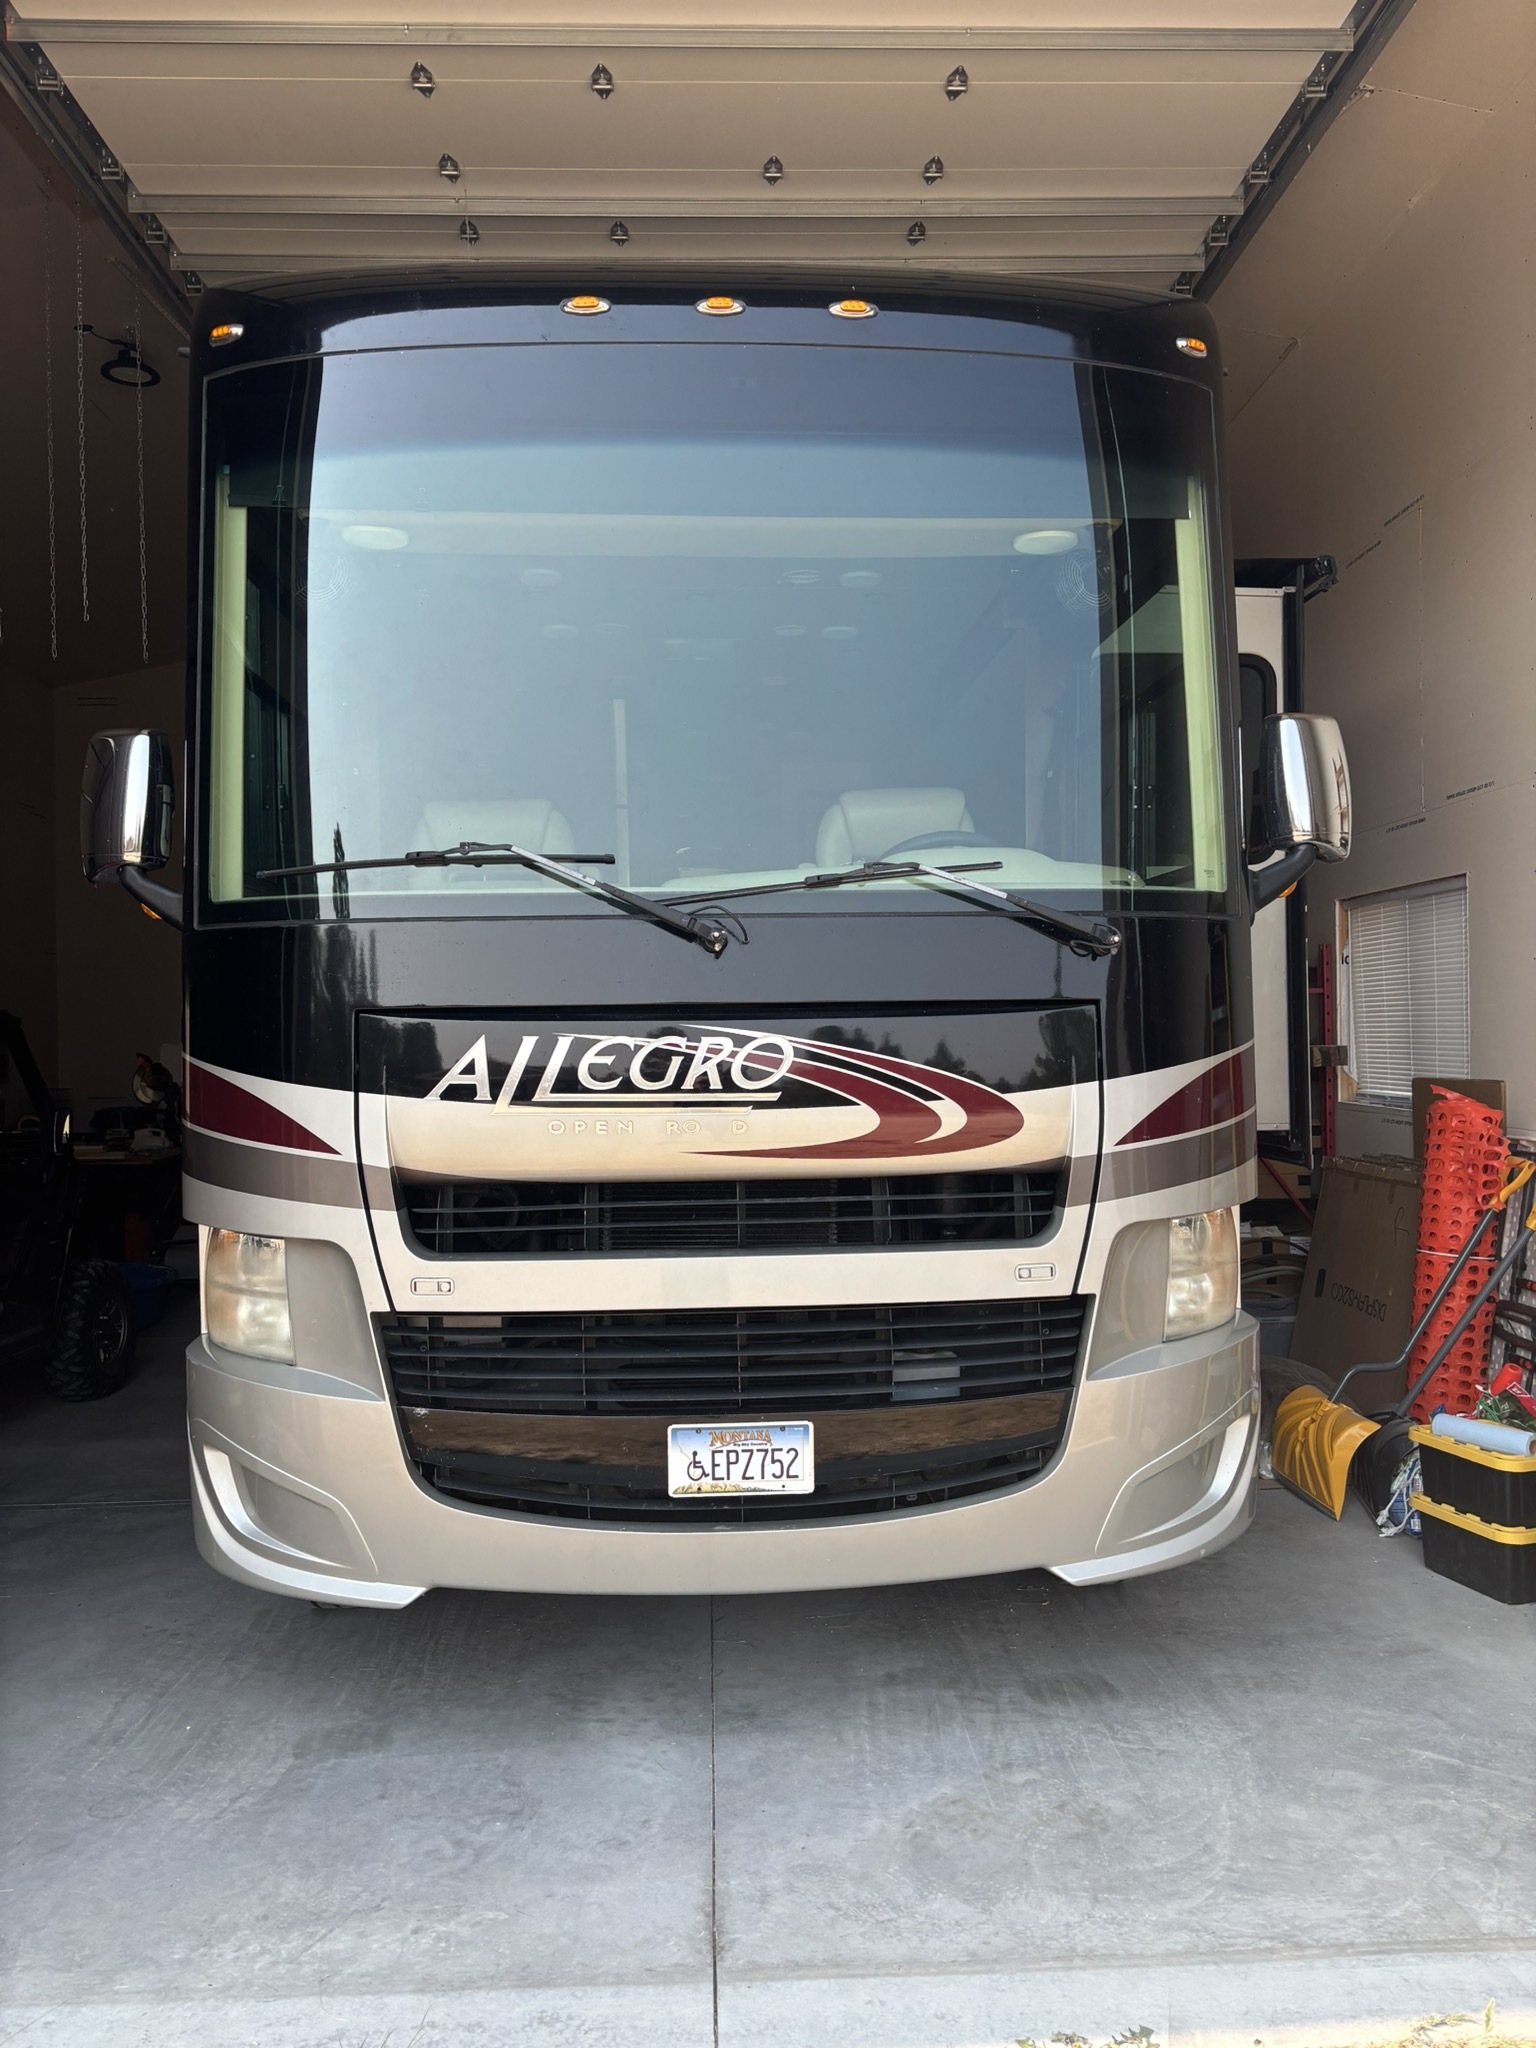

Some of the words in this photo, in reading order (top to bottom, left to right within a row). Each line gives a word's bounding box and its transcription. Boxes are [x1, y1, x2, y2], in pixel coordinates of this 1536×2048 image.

[424, 1034, 795, 1115] ALLEGRO
[547, 1119, 634, 1135] OPEN
[665, 1119, 749, 1135] ROD
[708, 1430, 772, 1447] MONTANA
[711, 1447, 799, 1480] EPZ752
